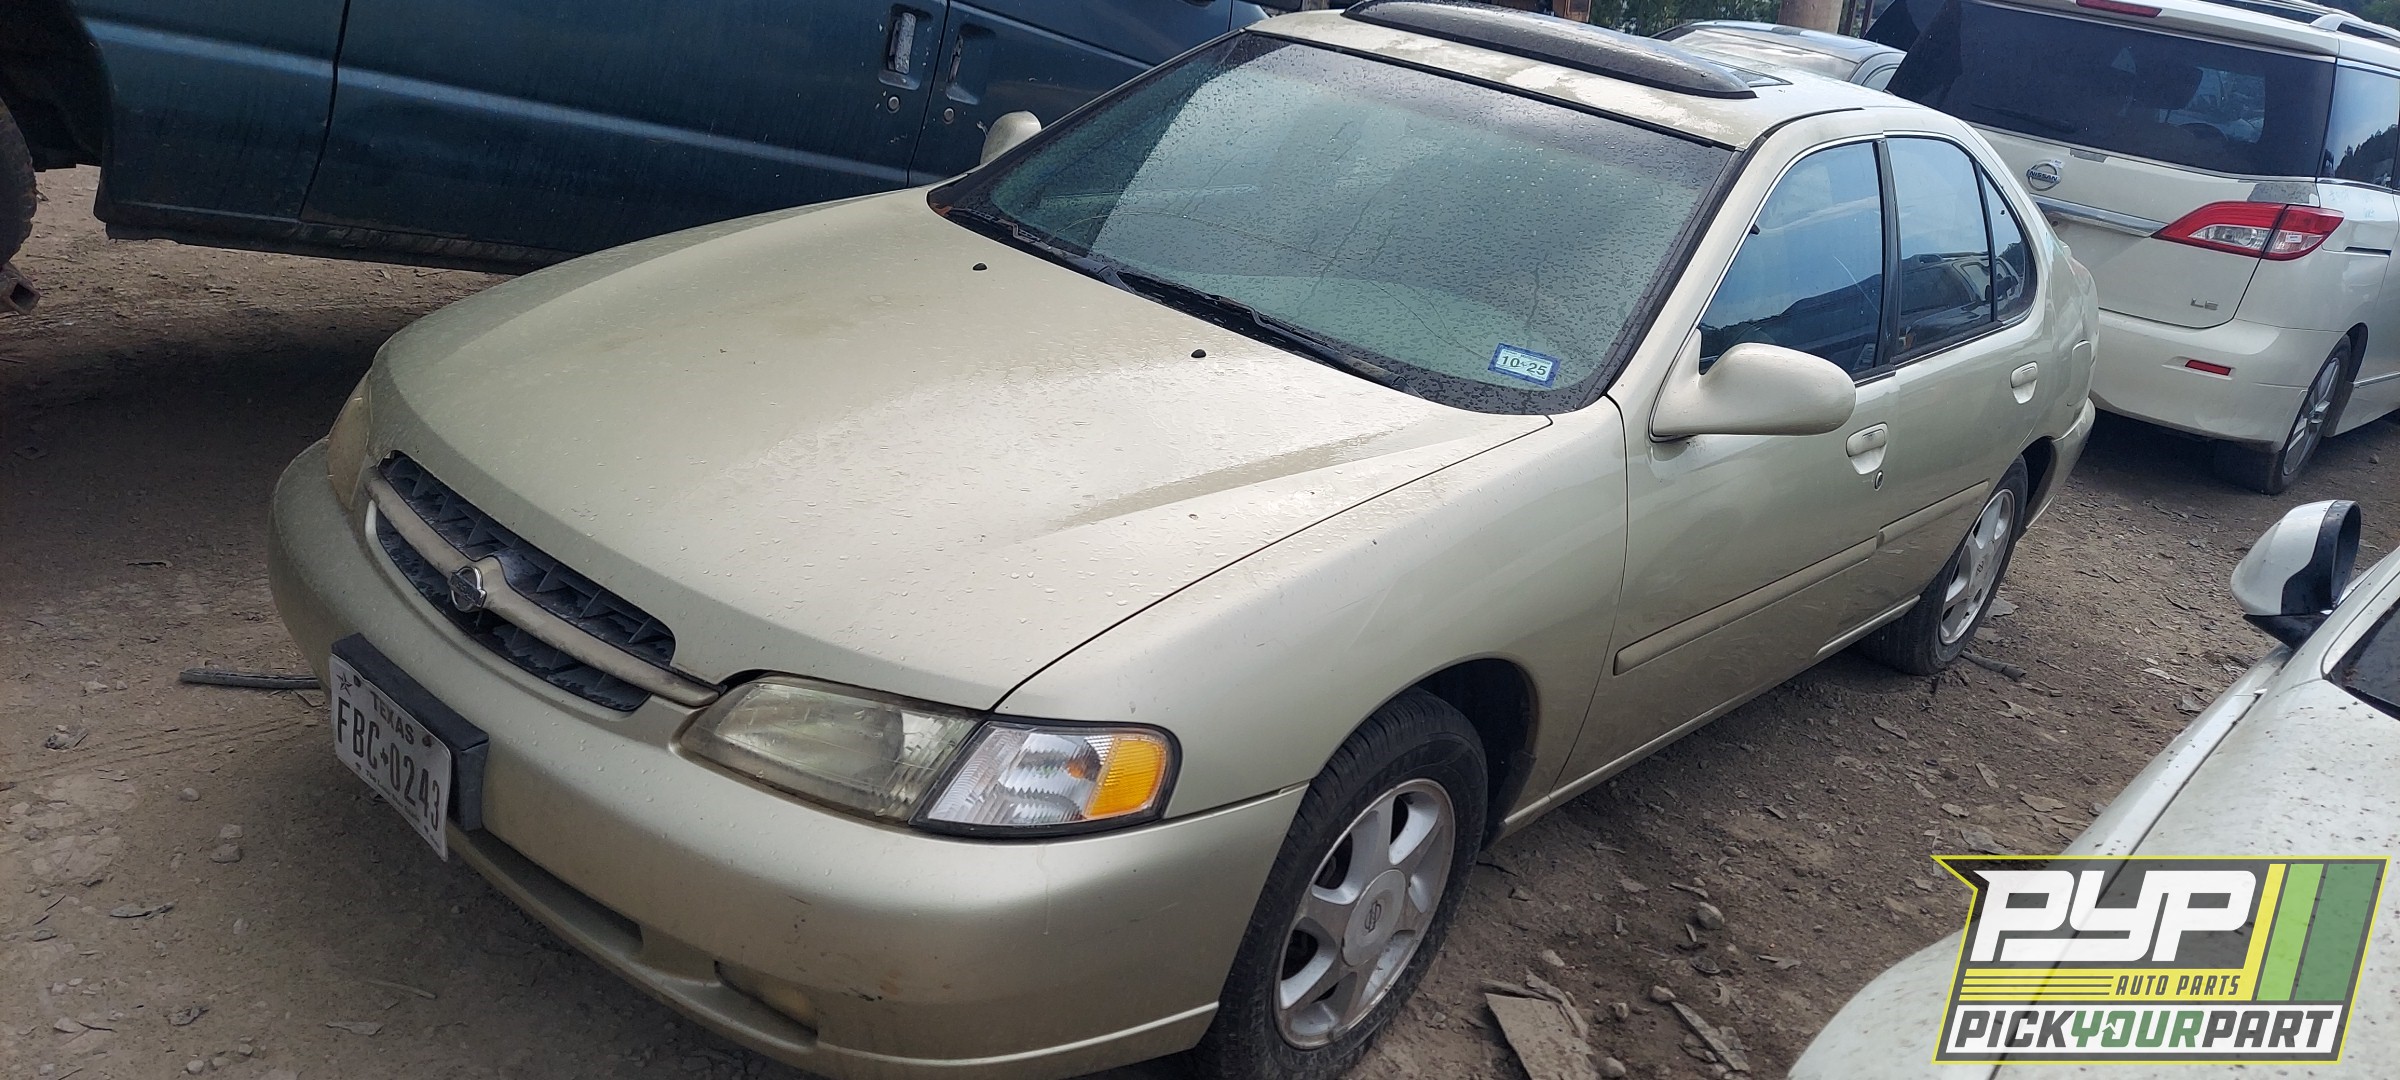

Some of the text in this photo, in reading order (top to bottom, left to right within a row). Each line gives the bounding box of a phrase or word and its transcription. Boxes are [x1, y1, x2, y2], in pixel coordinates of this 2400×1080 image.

[2029, 170, 2058, 181] NISSAN
[2190, 298, 2219, 311] LE
[370, 691, 414, 745] TEXAS
